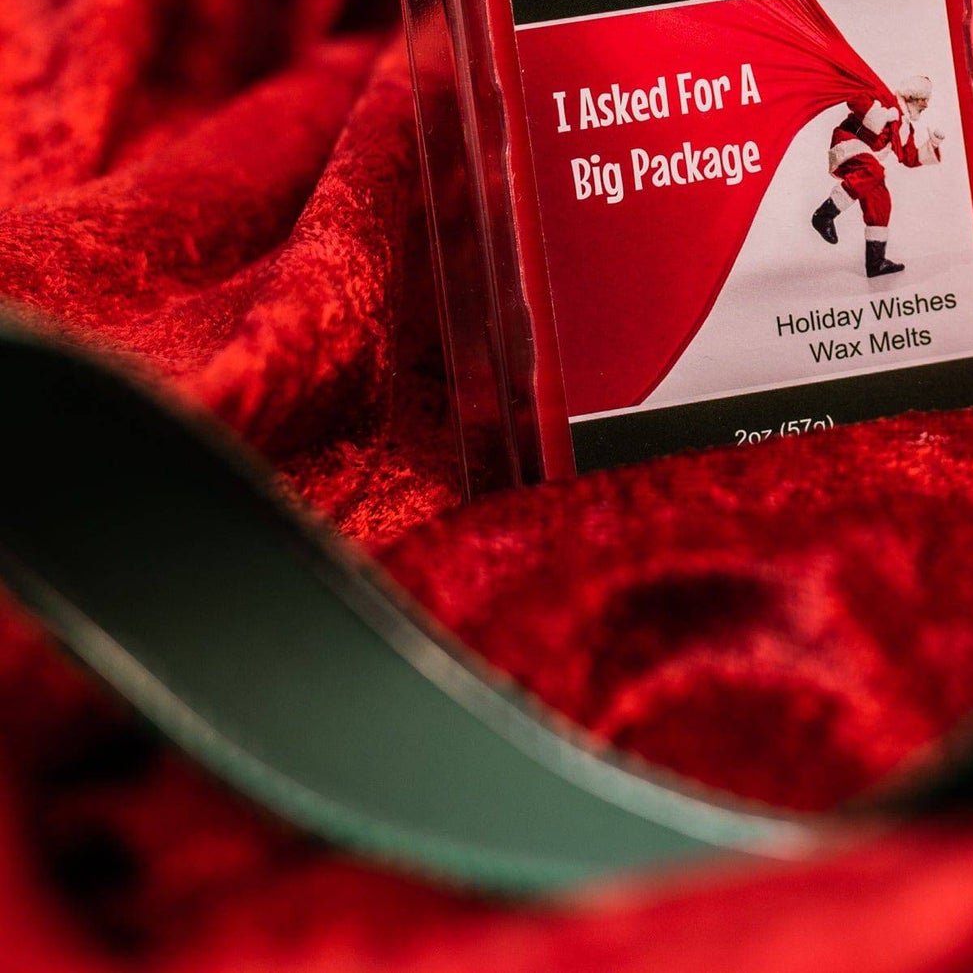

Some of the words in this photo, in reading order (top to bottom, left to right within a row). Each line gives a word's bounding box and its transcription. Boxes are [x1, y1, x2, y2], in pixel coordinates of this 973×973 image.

[553, 90, 572, 133] I
[579, 76, 669, 129] Asked
[677, 72, 731, 115] For
[740, 63, 762, 106] A
[571, 154, 624, 204] Big
[631, 140, 762, 192] Package
[776, 307, 864, 337] Holiday
[870, 292, 958, 321] Wishes
[809, 340, 863, 363] Wax
[869, 327, 932, 354] Melts
